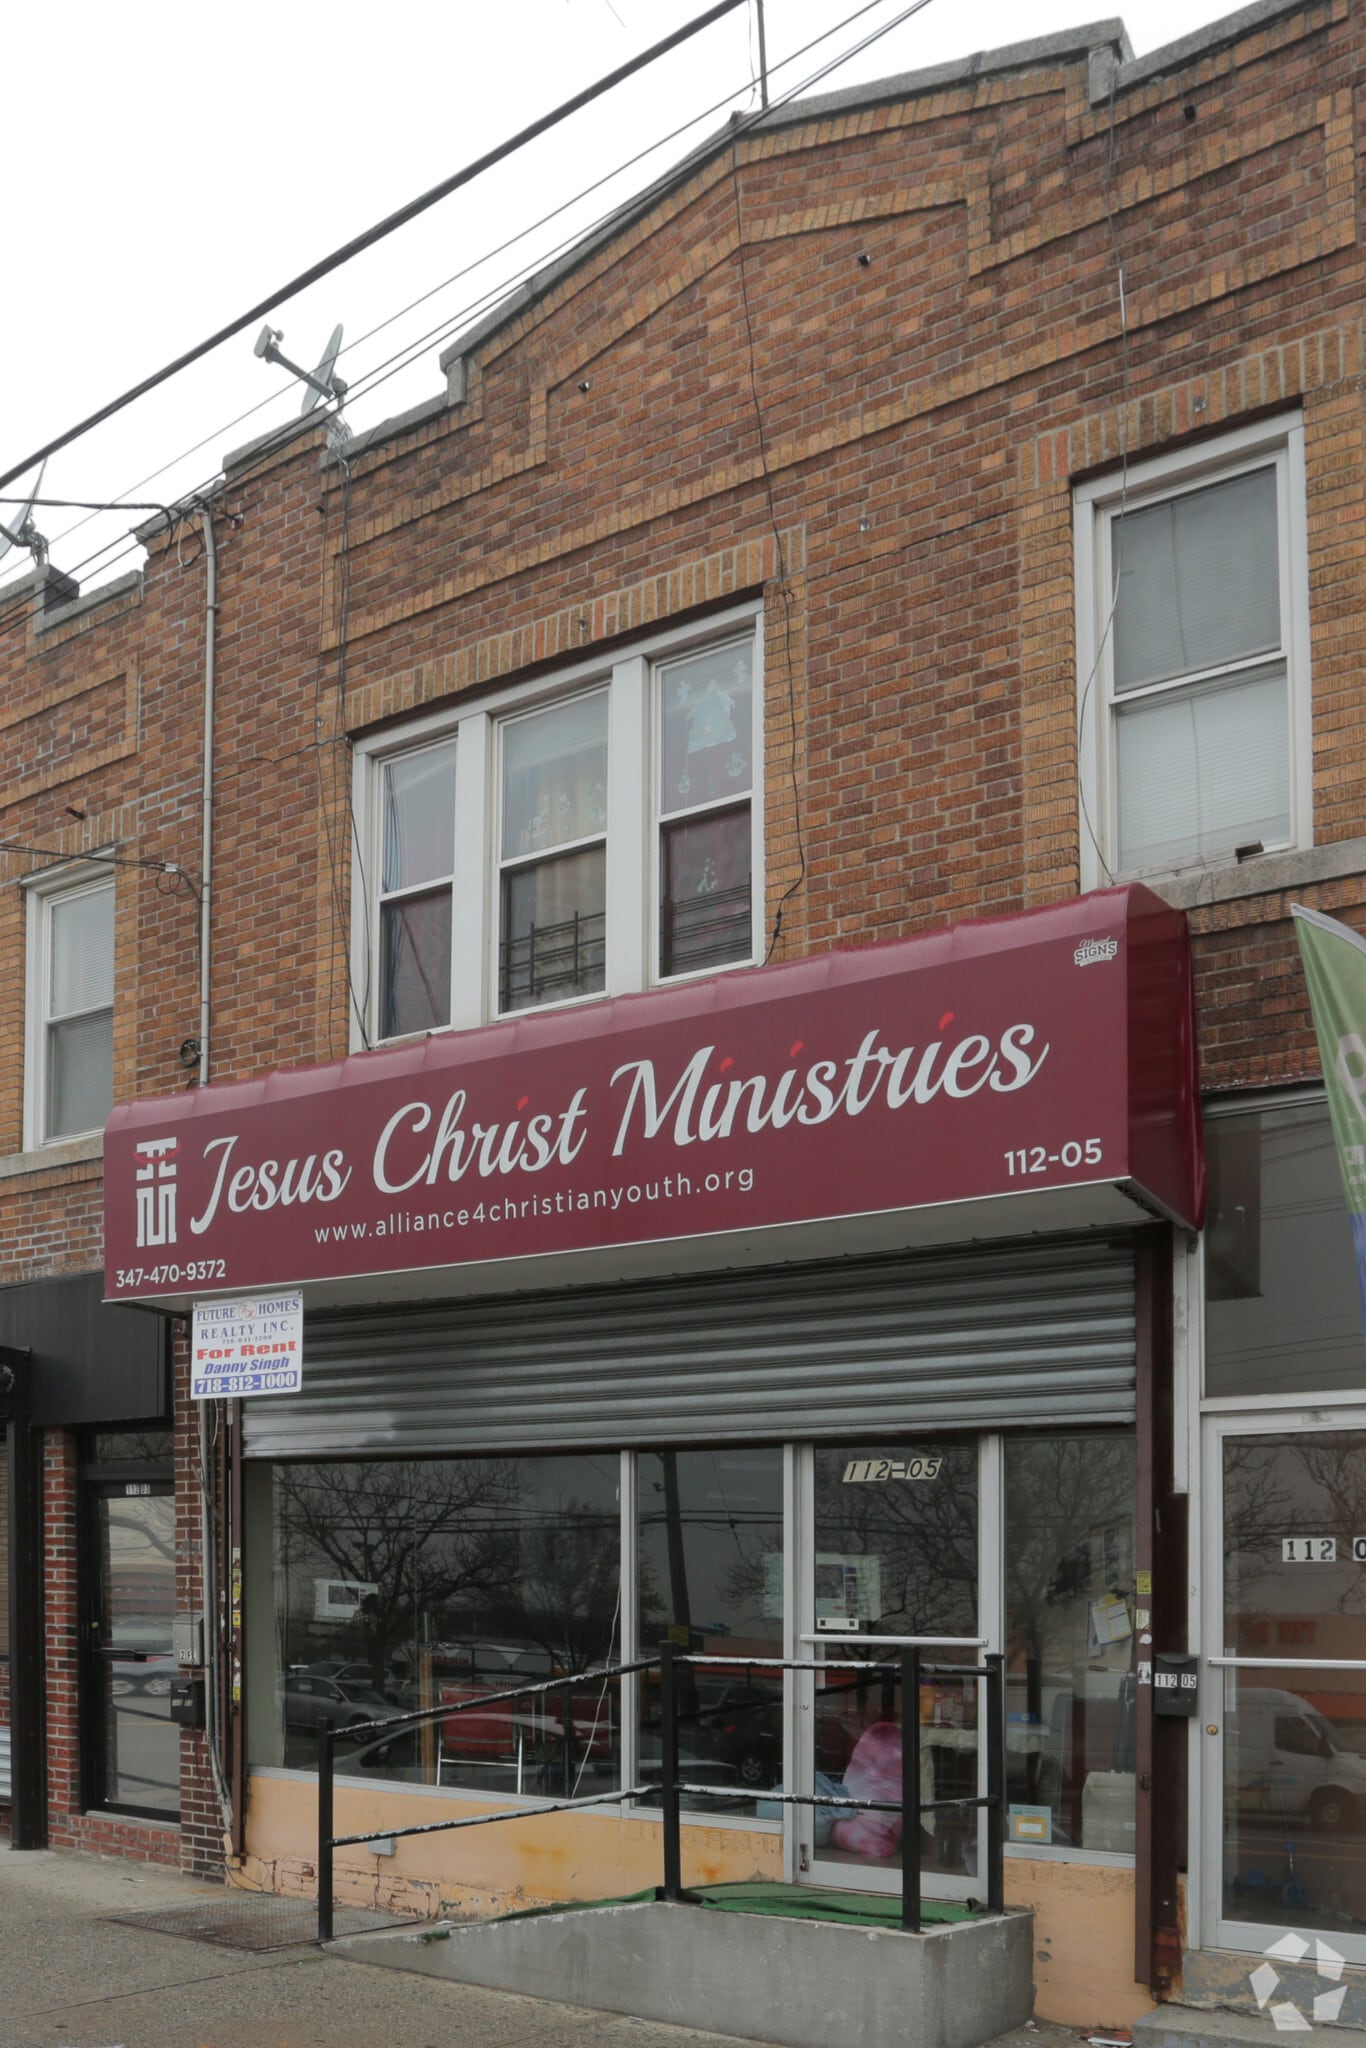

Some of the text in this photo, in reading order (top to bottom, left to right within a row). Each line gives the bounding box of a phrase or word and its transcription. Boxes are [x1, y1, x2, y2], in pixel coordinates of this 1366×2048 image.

[1075, 942, 1117, 962] SIGNS
[189, 1013, 1050, 1235] Jesus Christ Ministries
[1003, 1138, 1103, 1176] 112-05
[314, 1167, 755, 1244] www.alliance4christianyouth.org
[115, 1259, 227, 1289] 347-470-9372
[197, 1307, 236, 1321] FUTURE
[259, 1299, 299, 1315] HOMES
[201, 1320, 294, 1340] REALTY INC.
[197, 1340, 297, 1360] For Rent
[204, 1356, 290, 1375] Danny Singh
[197, 1372, 295, 1394] 718-812-1000
[1286, 1540, 1334, 1561] 112
[1156, 1673, 1196, 1687] 112 05
